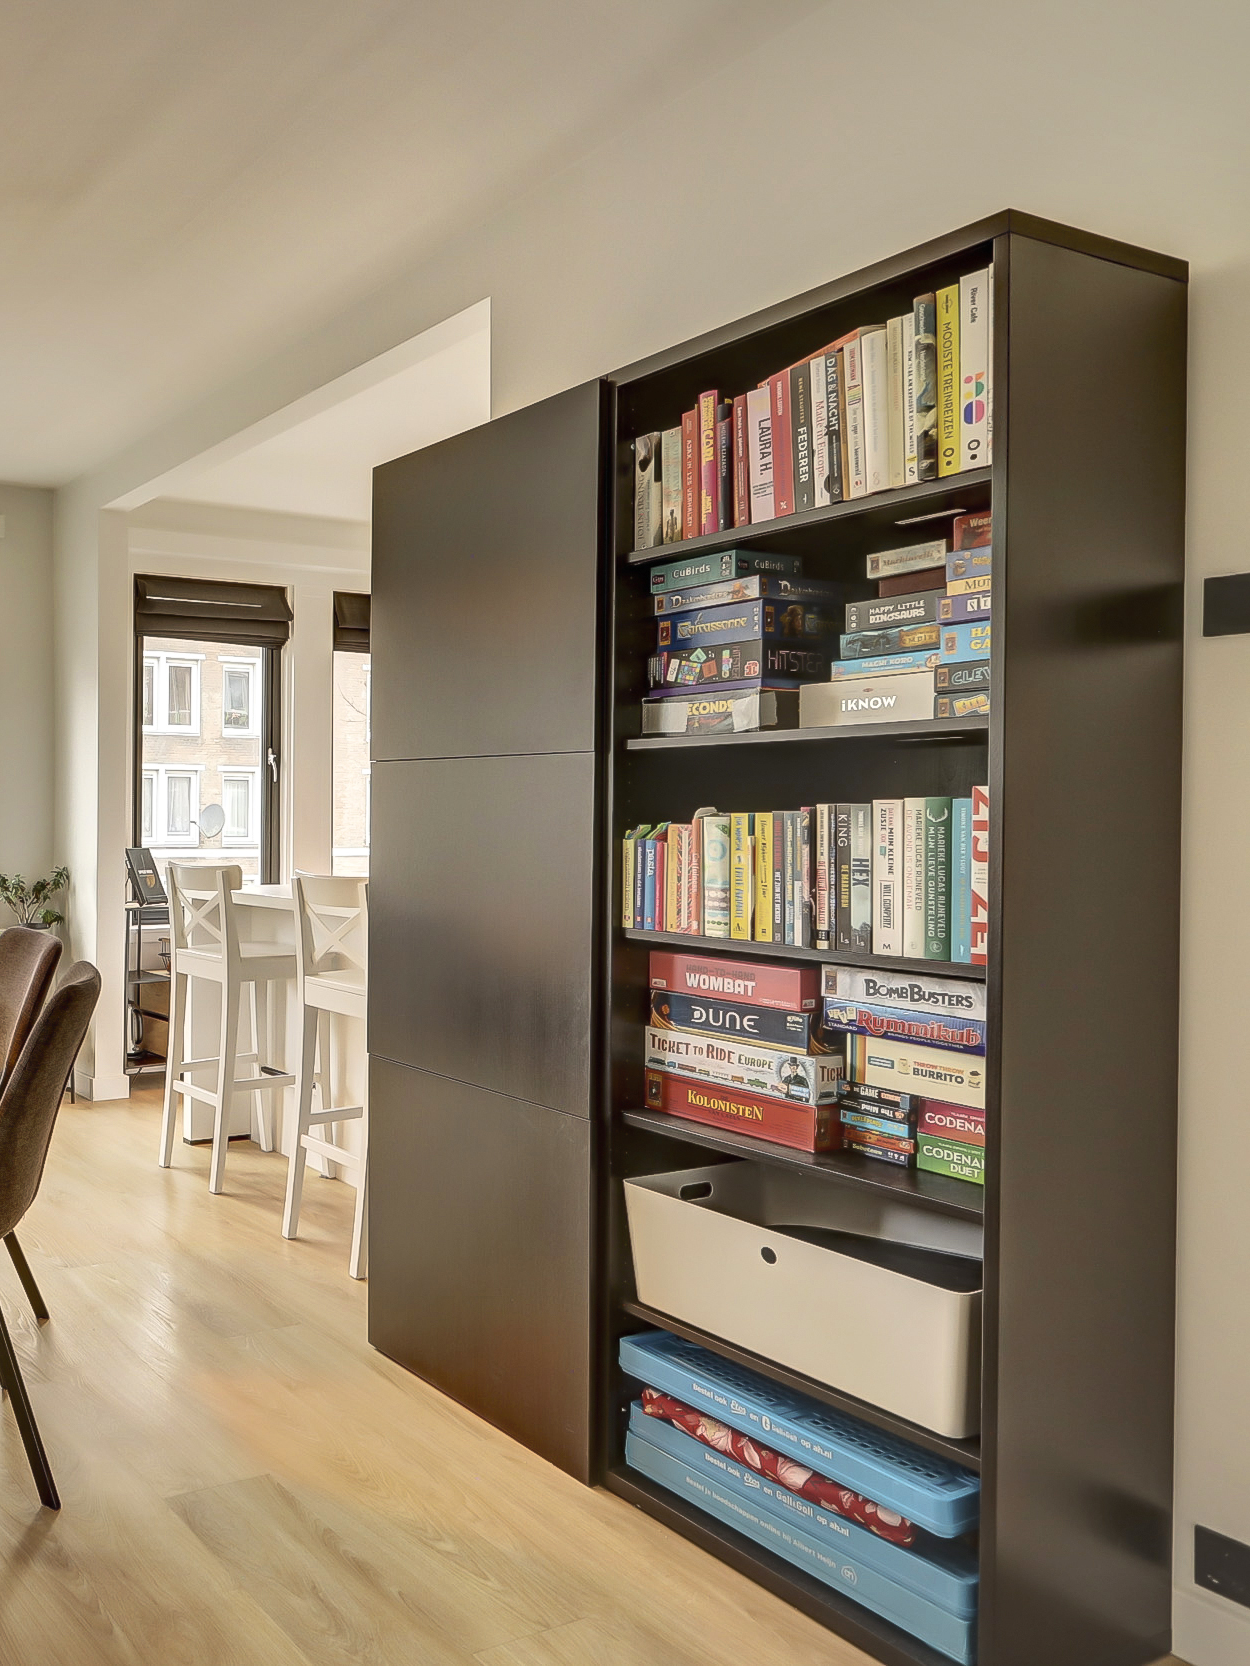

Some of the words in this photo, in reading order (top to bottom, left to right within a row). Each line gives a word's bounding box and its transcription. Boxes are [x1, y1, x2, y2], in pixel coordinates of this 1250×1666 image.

[970, 288, 978, 306] River
[970, 308, 978, 324] Cafe
[943, 322, 952, 370] MOOISTE
[826, 358, 836, 382] DAG
[828, 384, 837, 392] &
[815, 400, 825, 428] Made
[828, 393, 838, 430] NACHT
[944, 372, 953, 439] TREINREIZEN
[758, 417, 771, 460] LAURA
[817, 430, 826, 440] in
[687, 461, 692, 469] IN
[797, 427, 809, 482] FEDERER
[815, 442, 826, 478] Europe
[760, 462, 772, 476] H.
[674, 564, 710, 578] CuBirds
[755, 560, 784, 570] CuBirds
[870, 605, 894, 614] HAPPY
[898, 600, 925, 610] LITTLE
[870, 608, 925, 623] DINOSAURS
[906, 809, 912, 820] DE
[838, 814, 848, 847] KING
[937, 826, 945, 862] MARIEKE
[647, 848, 655, 876] pasta
[906, 856, 912, 864] IS
[852, 858, 869, 888] HEX
[937, 866, 945, 892] LUCAS
[841, 874, 849, 908] MARATHON
[883, 884, 891, 897] WILL
[883, 898, 891, 928] GOMPERTZ
[937, 896, 945, 938] RIJNEVELD
[686, 964, 756, 980] HAND-TO-HAND
[686, 972, 756, 996] WOMBAT
[691, 1005, 760, 1034] DUNE
[828, 1022, 857, 1031] STANDARD
[856, 1009, 981, 1046] Rummikub
[650, 1033, 691, 1055] TICKET
[706, 1044, 735, 1064] RIDE
[738, 1054, 774, 1070] EUROPE
[913, 1061, 938, 1069] THROW
[913, 1068, 964, 1084] BURRITO
[860, 1086, 878, 1098] GAME
[687, 1089, 763, 1121] KOLONISTEN
[862, 1104, 879, 1113] Mind
[881, 1108, 893, 1117] The
[925, 1112, 985, 1136] CODENA
[950, 1163, 980, 1178] DUET
[693, 1382, 713, 1399] Bestel
[714, 1394, 728, 1406] ook
[750, 1413, 759, 1422] en
[800, 1439, 811, 1450] op
[813, 1444, 832, 1459] ah.nl
[705, 1453, 727, 1470] Bestel
[728, 1466, 741, 1478] ook
[763, 1486, 773, 1496] en
[816, 1515, 828, 1526] op
[829, 1522, 849, 1537] ah.nl
[686, 1476, 705, 1492] Bestel
[712, 1492, 759, 1524] boodschappen
[760, 1520, 781, 1537] online
[782, 1533, 792, 1544] bij
[793, 1539, 816, 1557] Albert
[817, 1552, 836, 1569] Heijn
